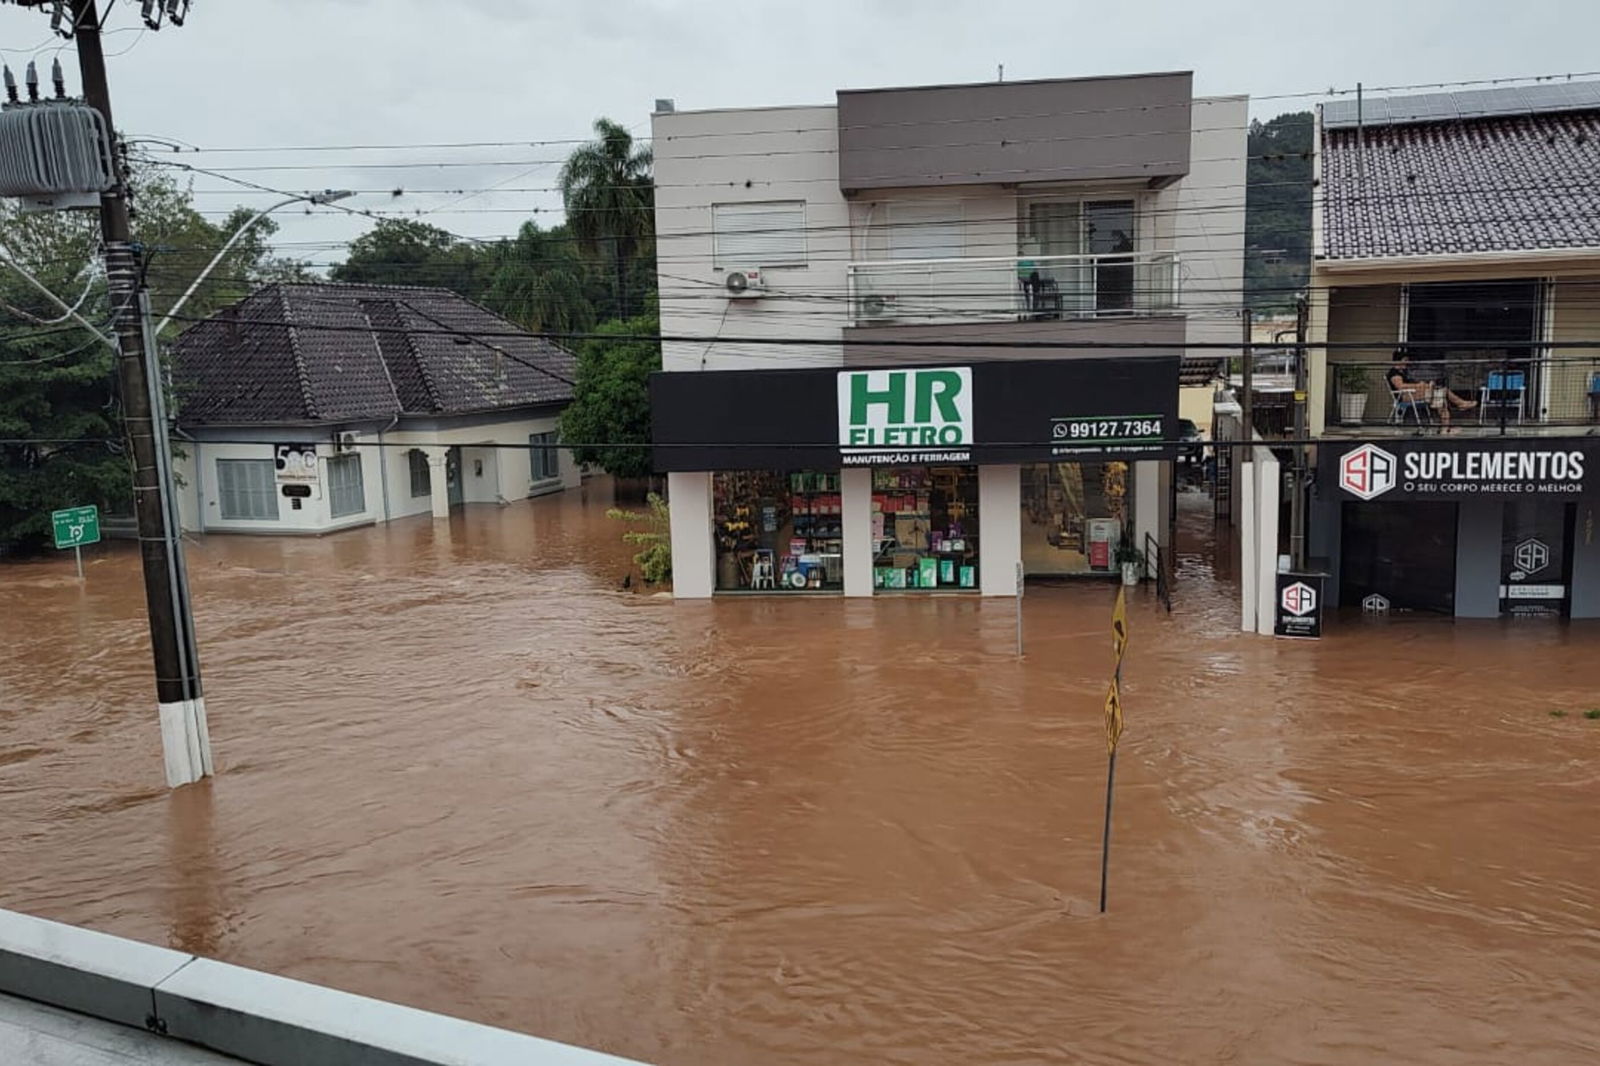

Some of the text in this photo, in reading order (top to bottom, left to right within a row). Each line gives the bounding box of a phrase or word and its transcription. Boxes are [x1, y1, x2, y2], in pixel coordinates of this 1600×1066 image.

[849, 370, 962, 425] HR
[1070, 421, 1161, 437] 99127.7364
[843, 452, 970, 464] MANUTENÇÃO E FERRAGEM
[1404, 451, 1584, 479] SUPLEMENTOS
[1346, 451, 1391, 492] SA
[1404, 482, 1583, 492] O SEU CORPO MERECE O MELHOR
[1518, 543, 1546, 569] SA
[1286, 586, 1312, 611] SA
